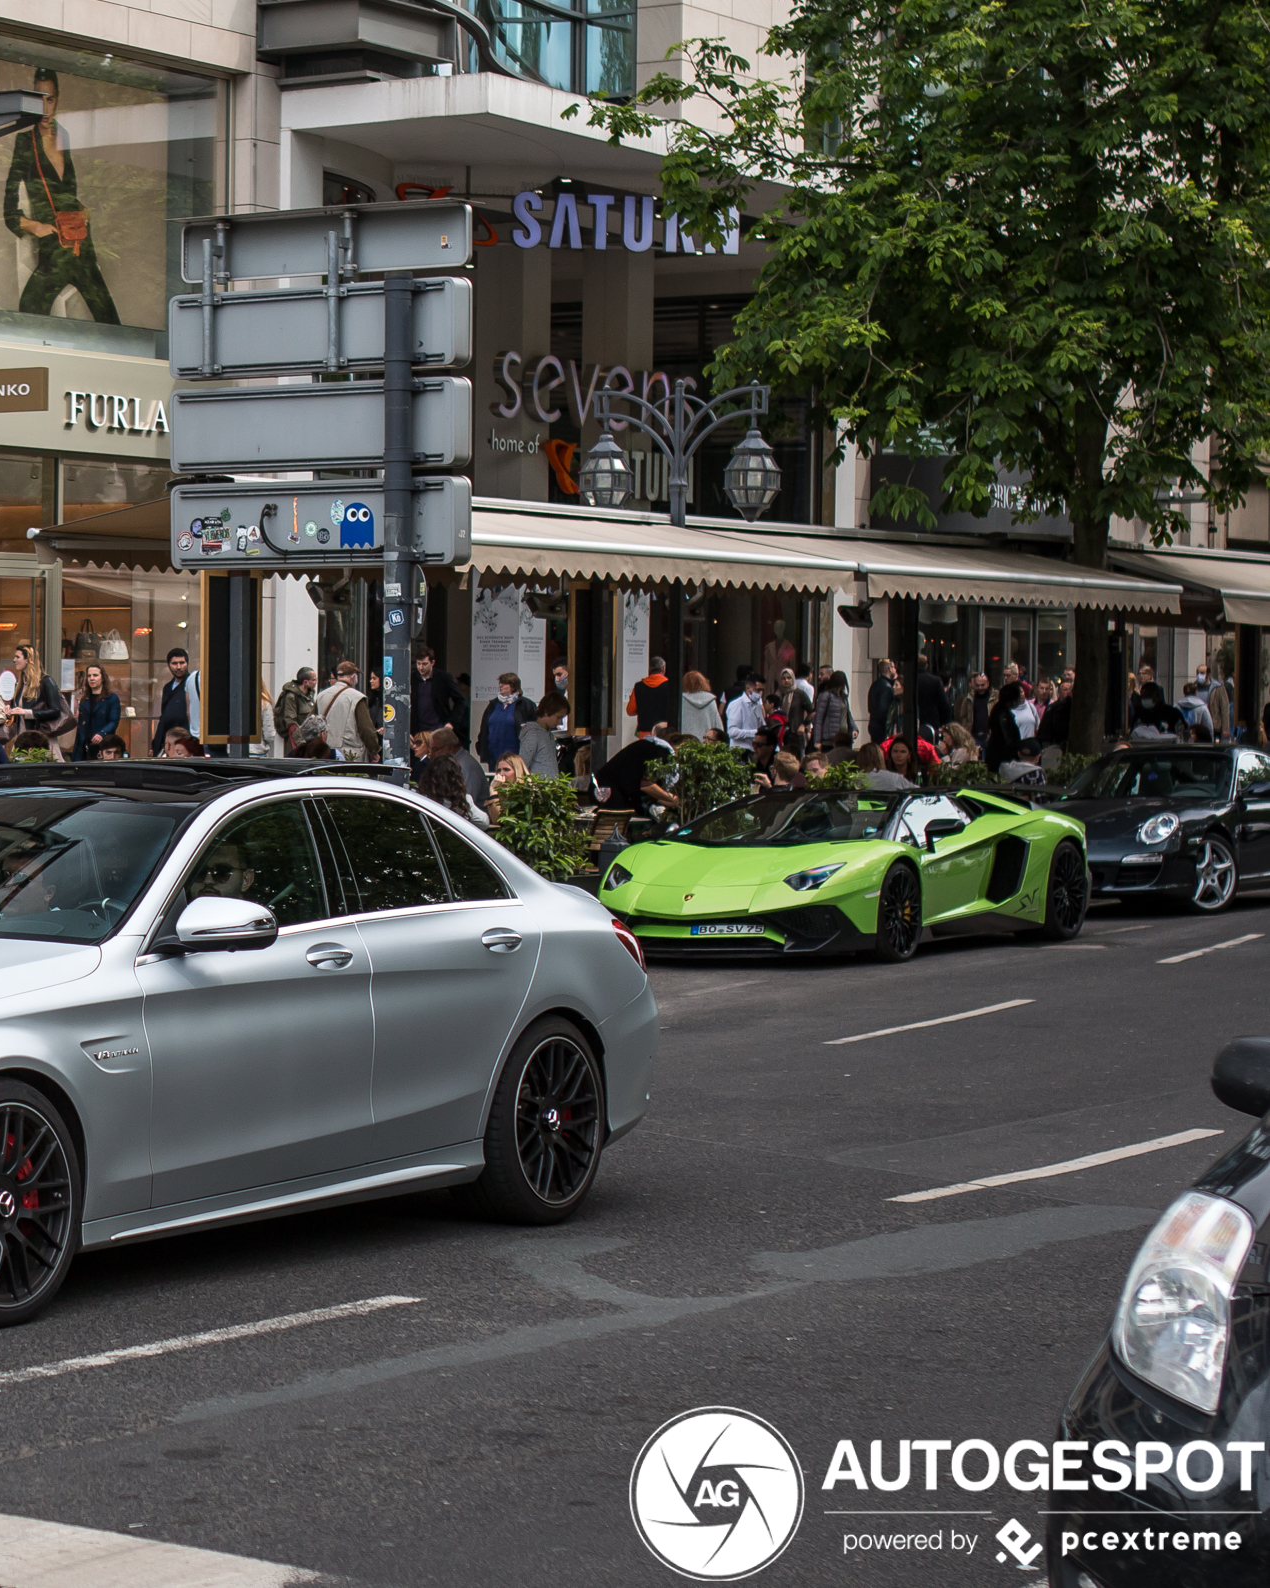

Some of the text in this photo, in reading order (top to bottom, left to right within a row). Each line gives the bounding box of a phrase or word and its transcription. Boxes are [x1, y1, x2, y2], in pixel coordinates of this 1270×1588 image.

[68, 390, 170, 433] FURLA
[491, 427, 541, 455] home of
[699, 926, 717, 934] BO
[726, 925, 744, 933] SV
[747, 925, 763, 933] 75
